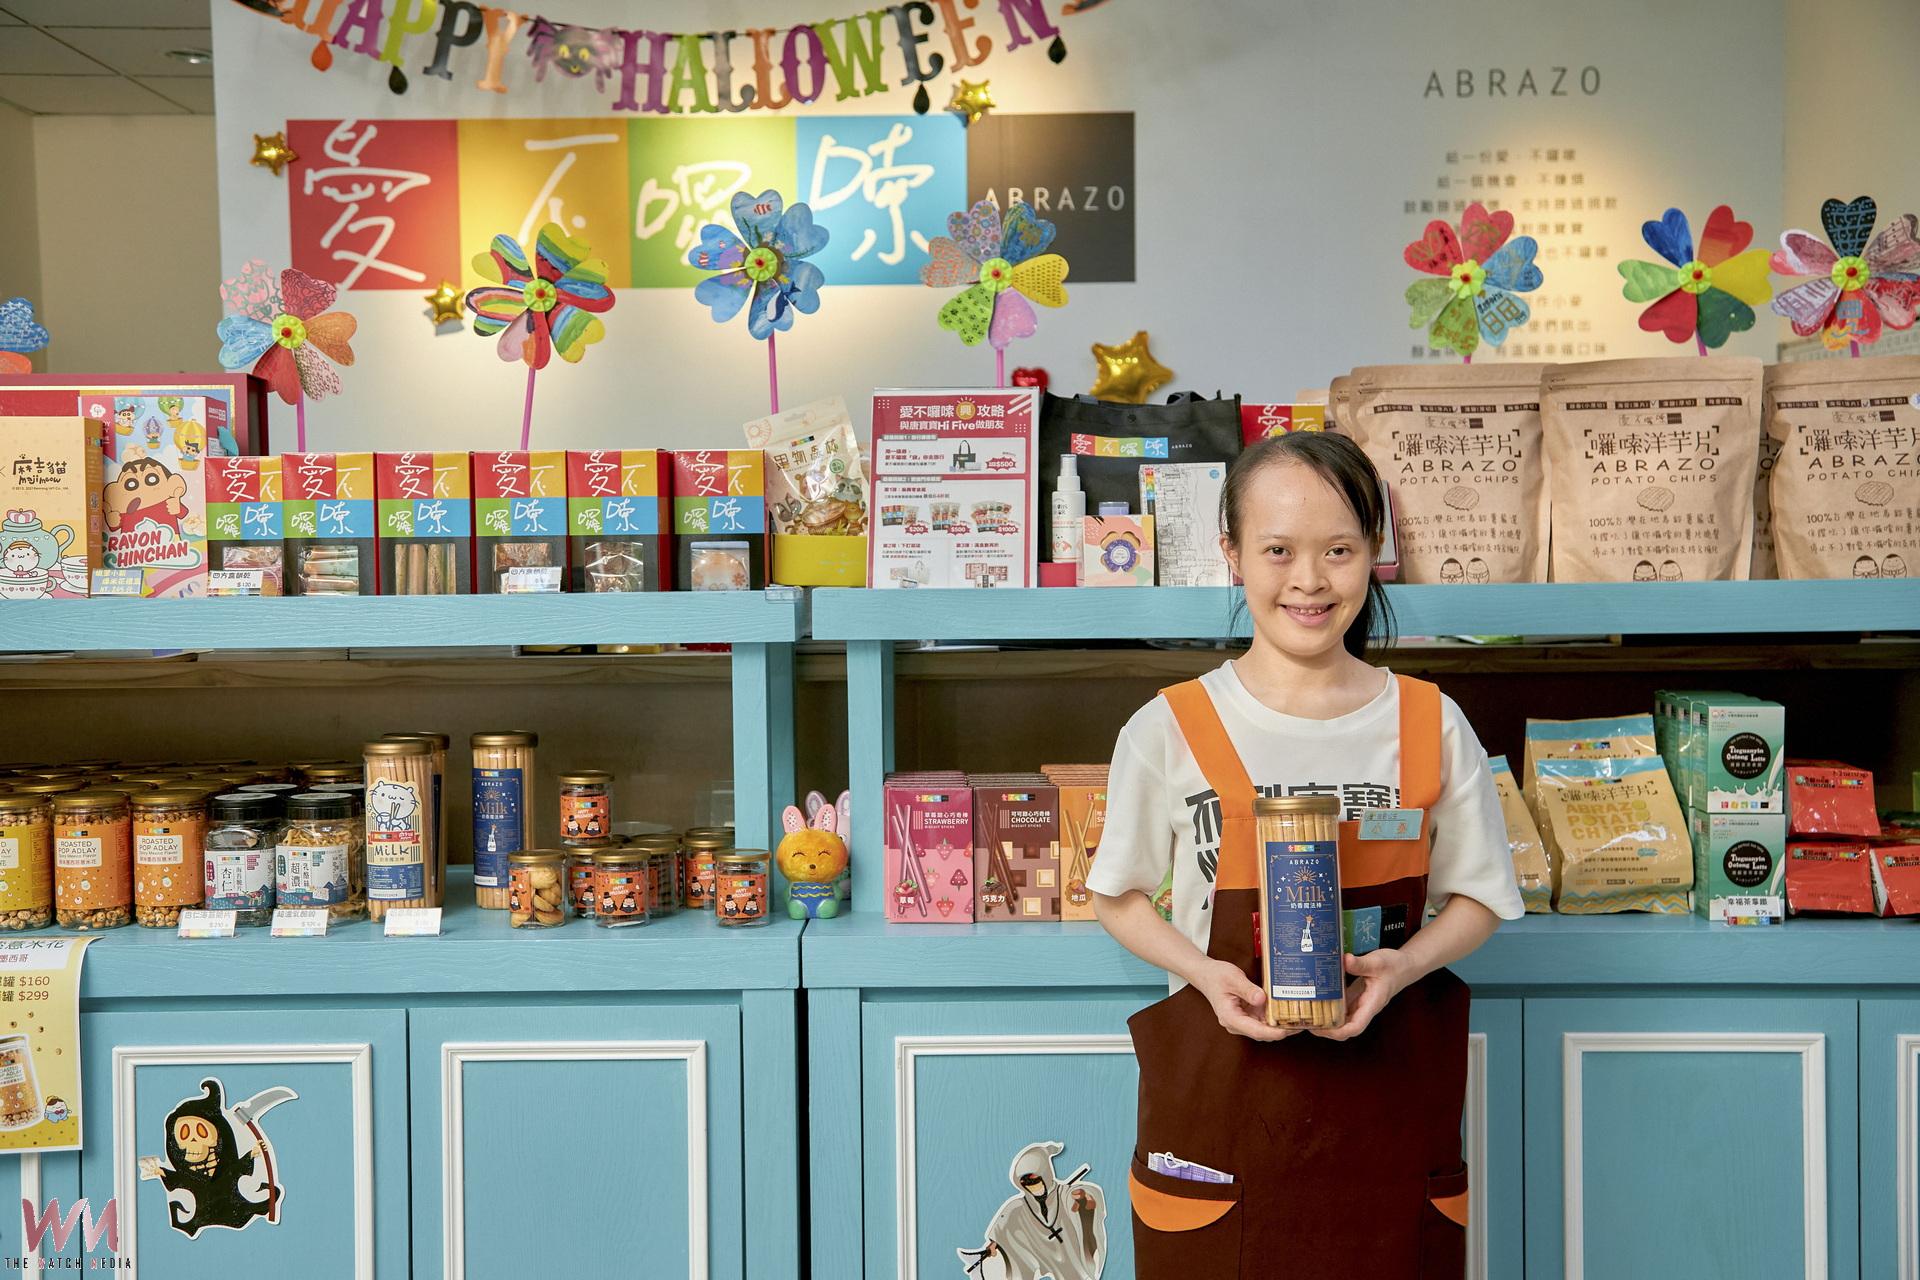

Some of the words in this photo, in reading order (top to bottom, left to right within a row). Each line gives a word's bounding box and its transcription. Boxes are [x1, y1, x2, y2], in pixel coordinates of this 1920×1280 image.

[612, 0, 1060, 114] HALLOWEEN
[1424, 66, 1601, 98] ABRAZO
[982, 186, 1126, 212] ABRAZO
[1399, 433, 1514, 456] 囉嗦洋芋片
[1590, 430, 1712, 455] 囉嗦洋芋片
[1401, 460, 1517, 473] ABRAZO
[1593, 457, 1716, 473] ABRAZO
[1400, 476, 1461, 486] POTATO
[1474, 475, 1519, 484] CHIPS
[1592, 475, 1656, 486] POTATO
[1670, 474, 1717, 483] CHIPS
[1808, 471, 1873, 481] POTATO
[1888, 469, 1920, 478] CHI
[480, 802, 507, 814] Milk
[1566, 800, 1647, 814] ABRAZO
[1568, 811, 1649, 826] POTATO
[982, 895, 1005, 903] 巧克力
[1071, 894, 1086, 902] 地瓜
[1285, 885, 1326, 902] Milk
[0, 976, 15, 987] 罐
[19, 976, 50, 987] $160
[0, 991, 14, 1002] 罐
[18, 991, 49, 1002] $299
